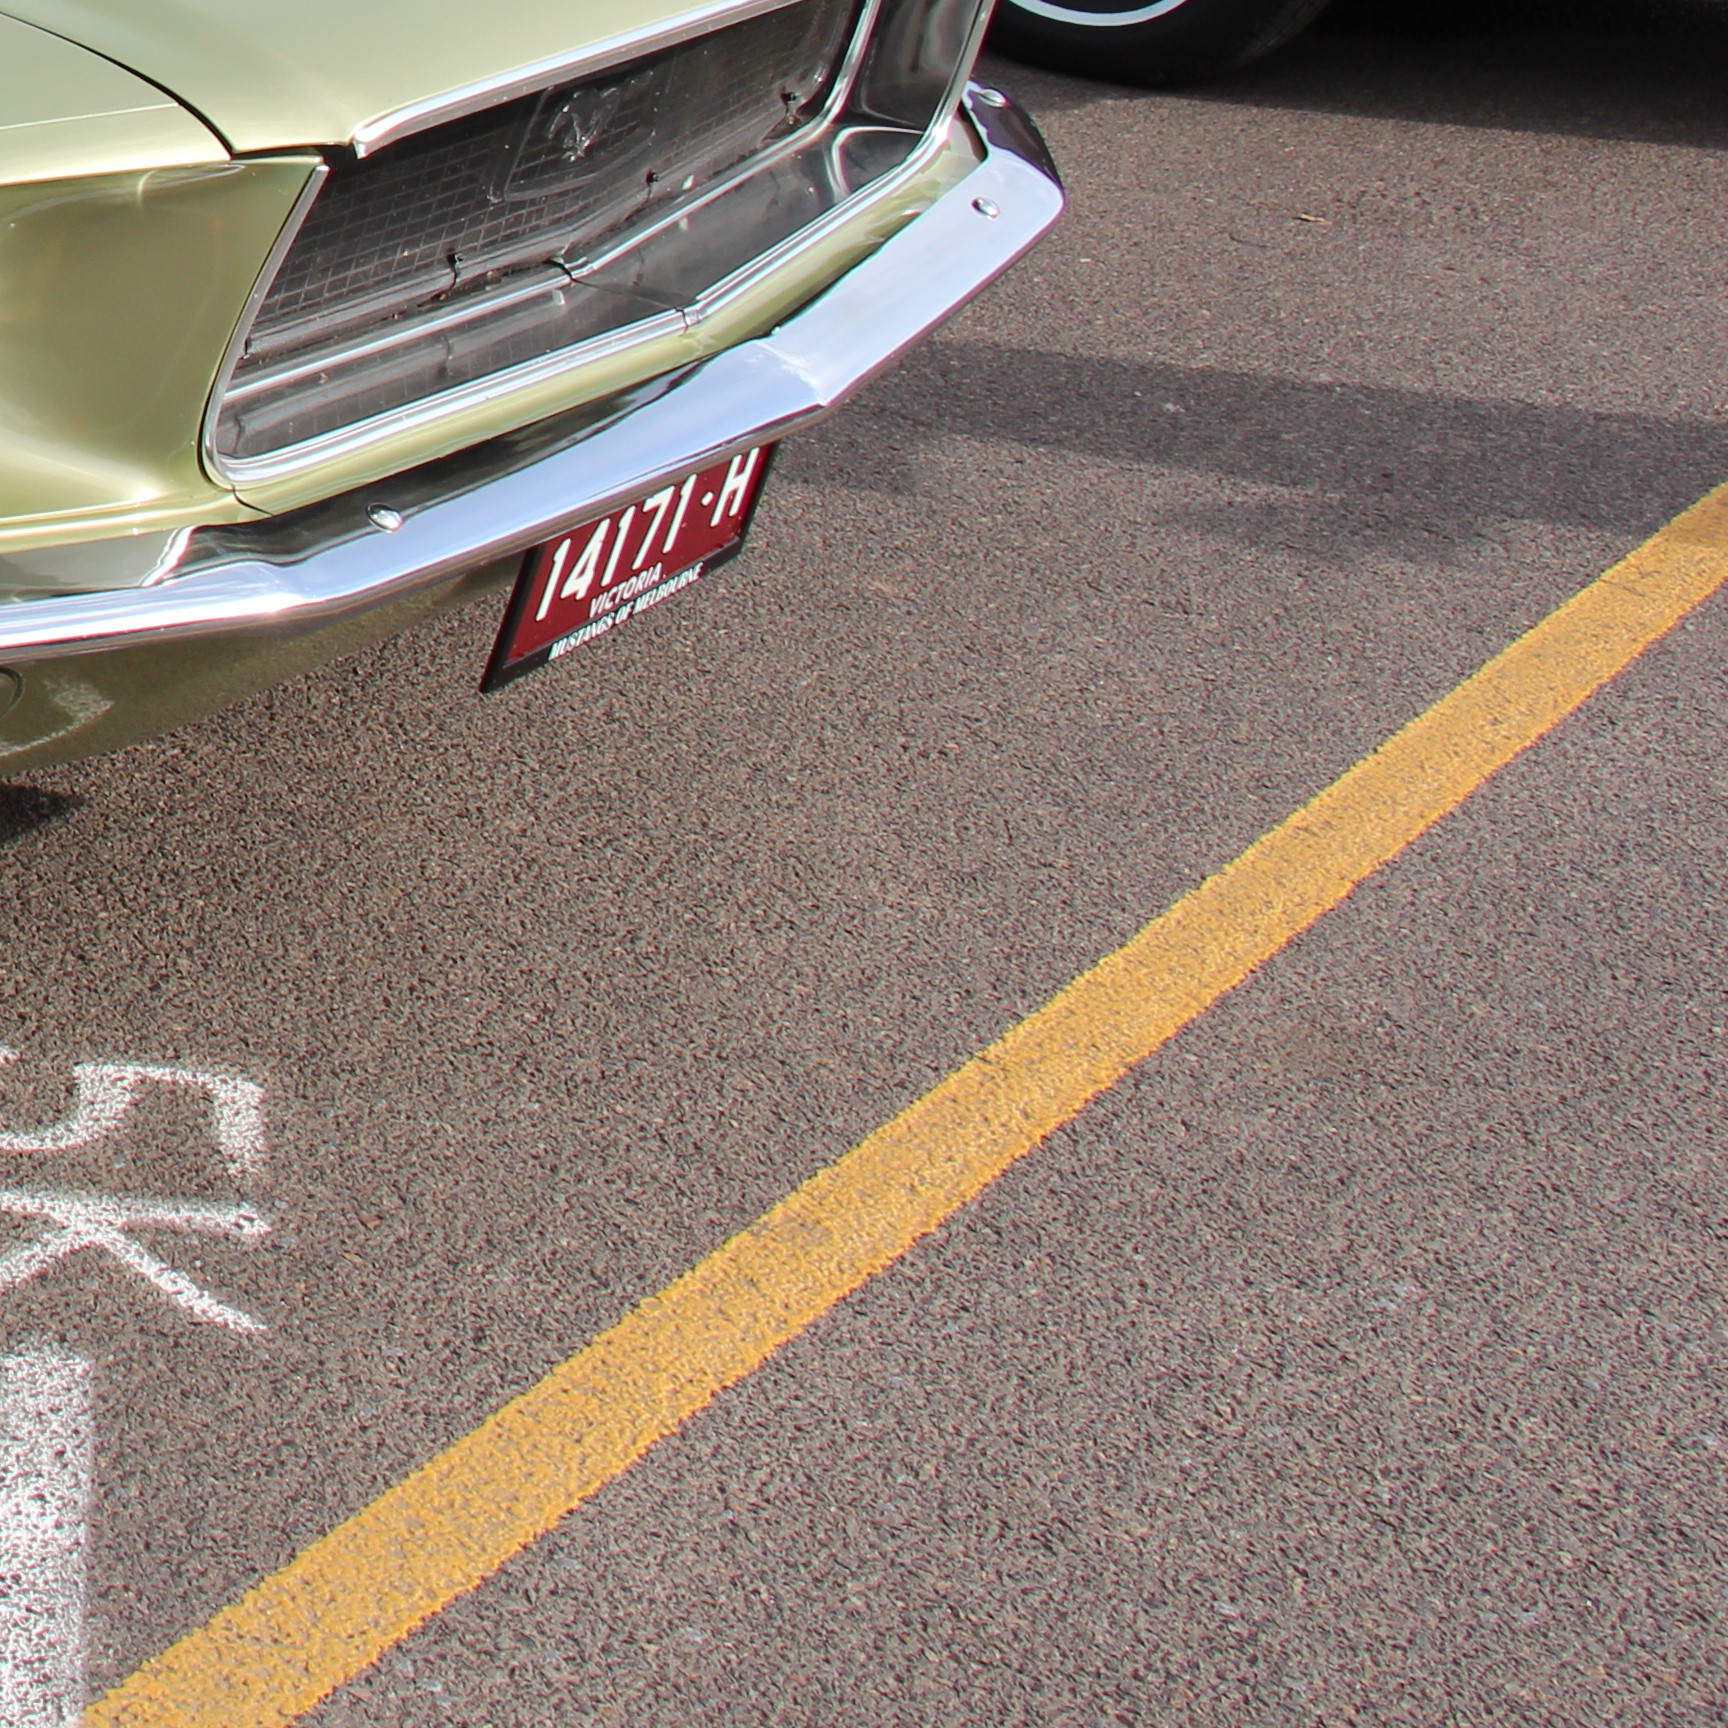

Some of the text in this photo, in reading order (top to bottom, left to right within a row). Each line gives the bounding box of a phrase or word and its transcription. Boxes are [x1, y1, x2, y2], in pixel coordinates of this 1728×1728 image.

[547, 561, 704, 661] MUSTANGS OF MELBOURNE
[589, 561, 663, 619] VICTORIA
